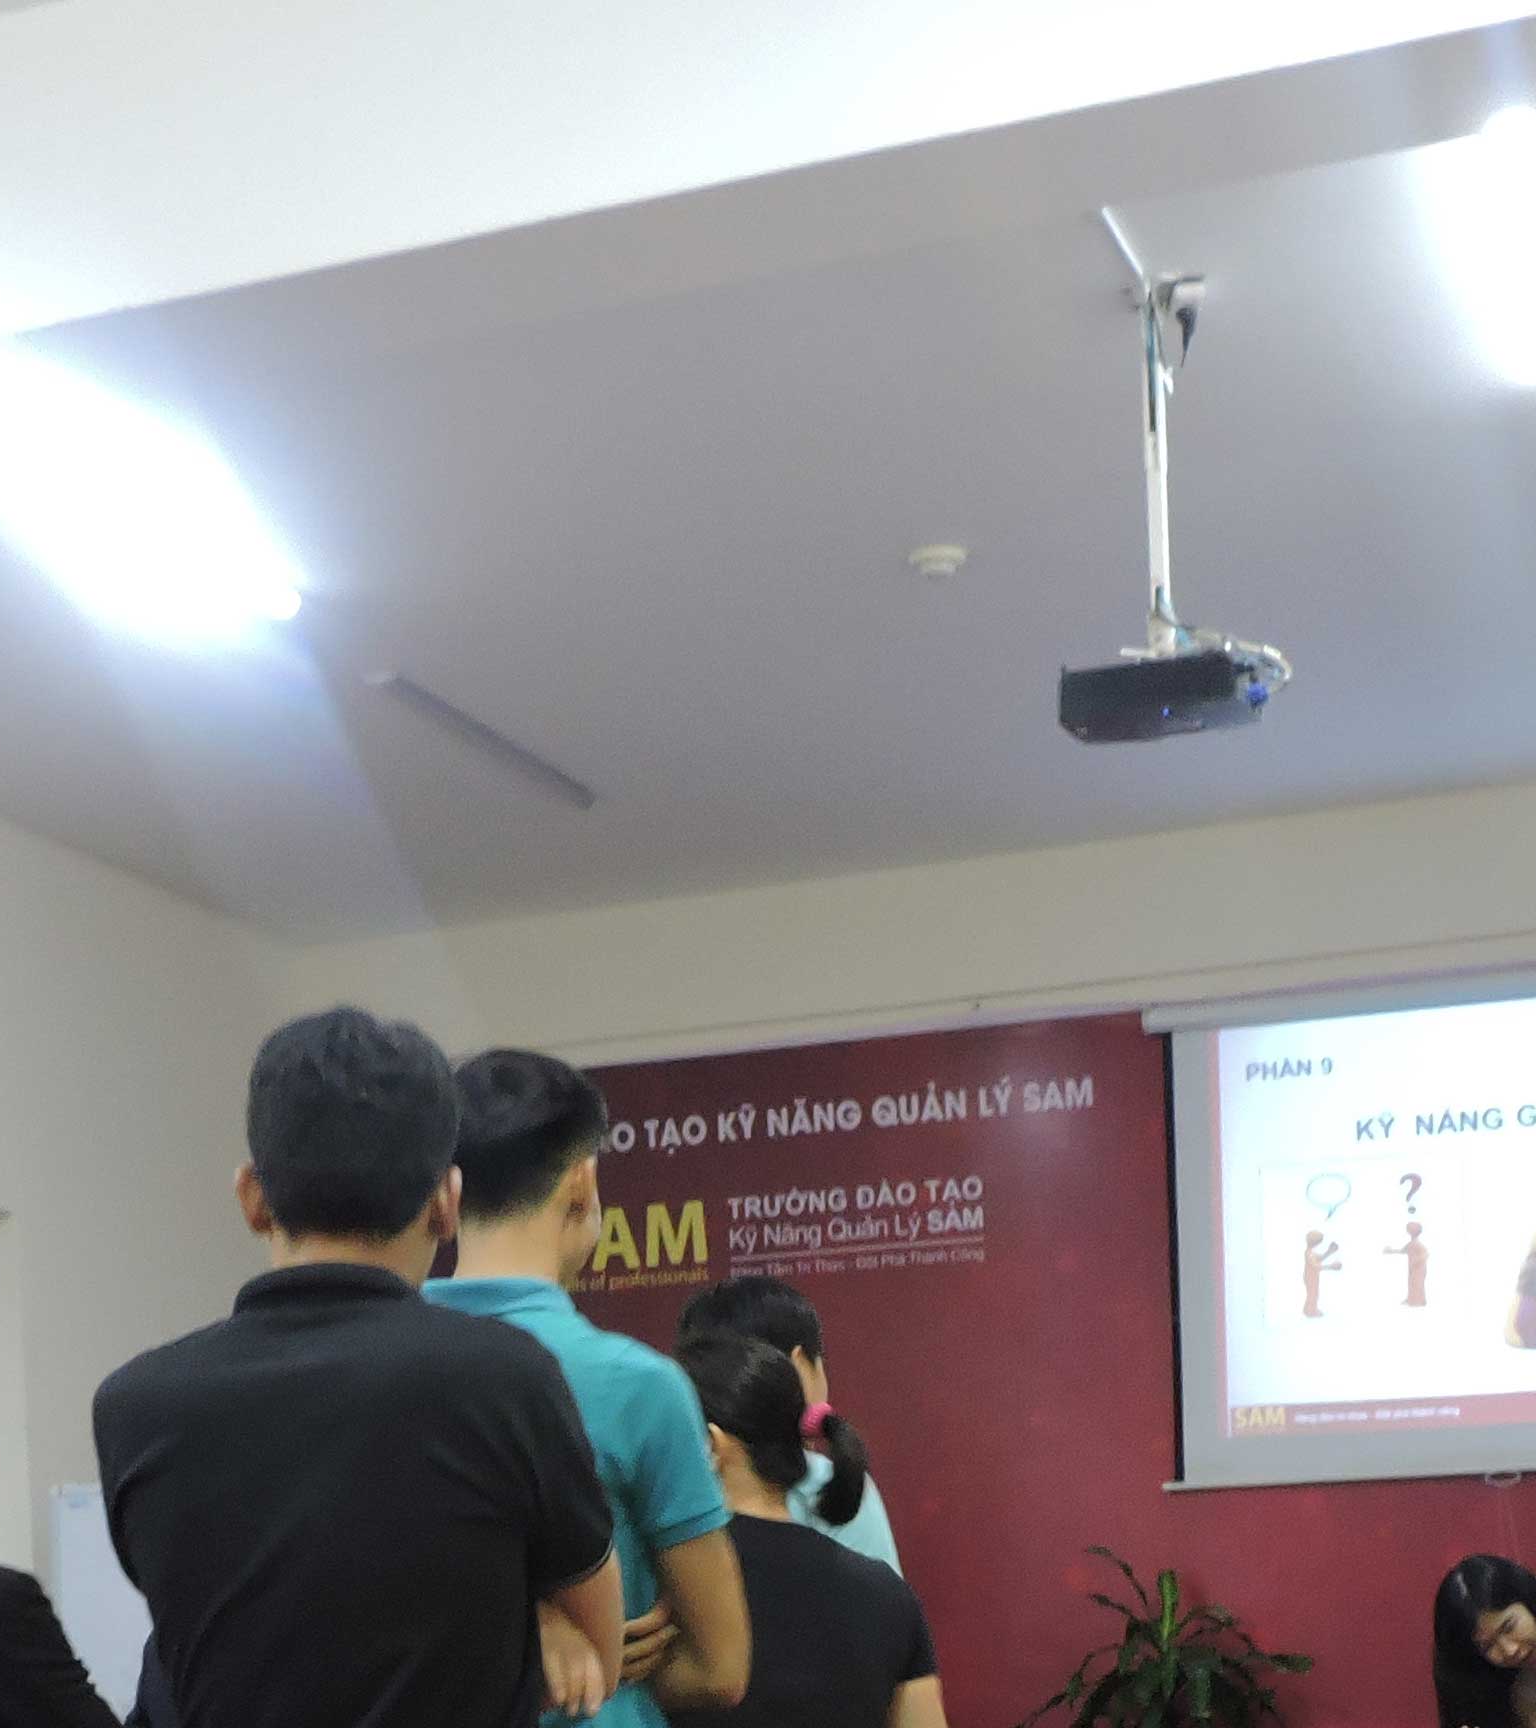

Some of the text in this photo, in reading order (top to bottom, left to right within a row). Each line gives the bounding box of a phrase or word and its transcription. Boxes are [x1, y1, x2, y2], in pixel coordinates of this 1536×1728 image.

[643, 1114, 707, 1155] TẠO
[717, 1103, 756, 1143] KỸ
[767, 1098, 862, 1138] NĂNG
[872, 1081, 966, 1127] QUẢN
[978, 1075, 1013, 1118] LÝ
[1023, 1075, 1094, 1112] SAM
[728, 1186, 847, 1220] TRƯỜNG
[924, 1175, 984, 1206] TẠO
[591, 1199, 709, 1272] AM
[894, 1211, 922, 1241] Lý
[927, 1205, 984, 1233] SAM
[1234, 1406, 1286, 1428] SAM
